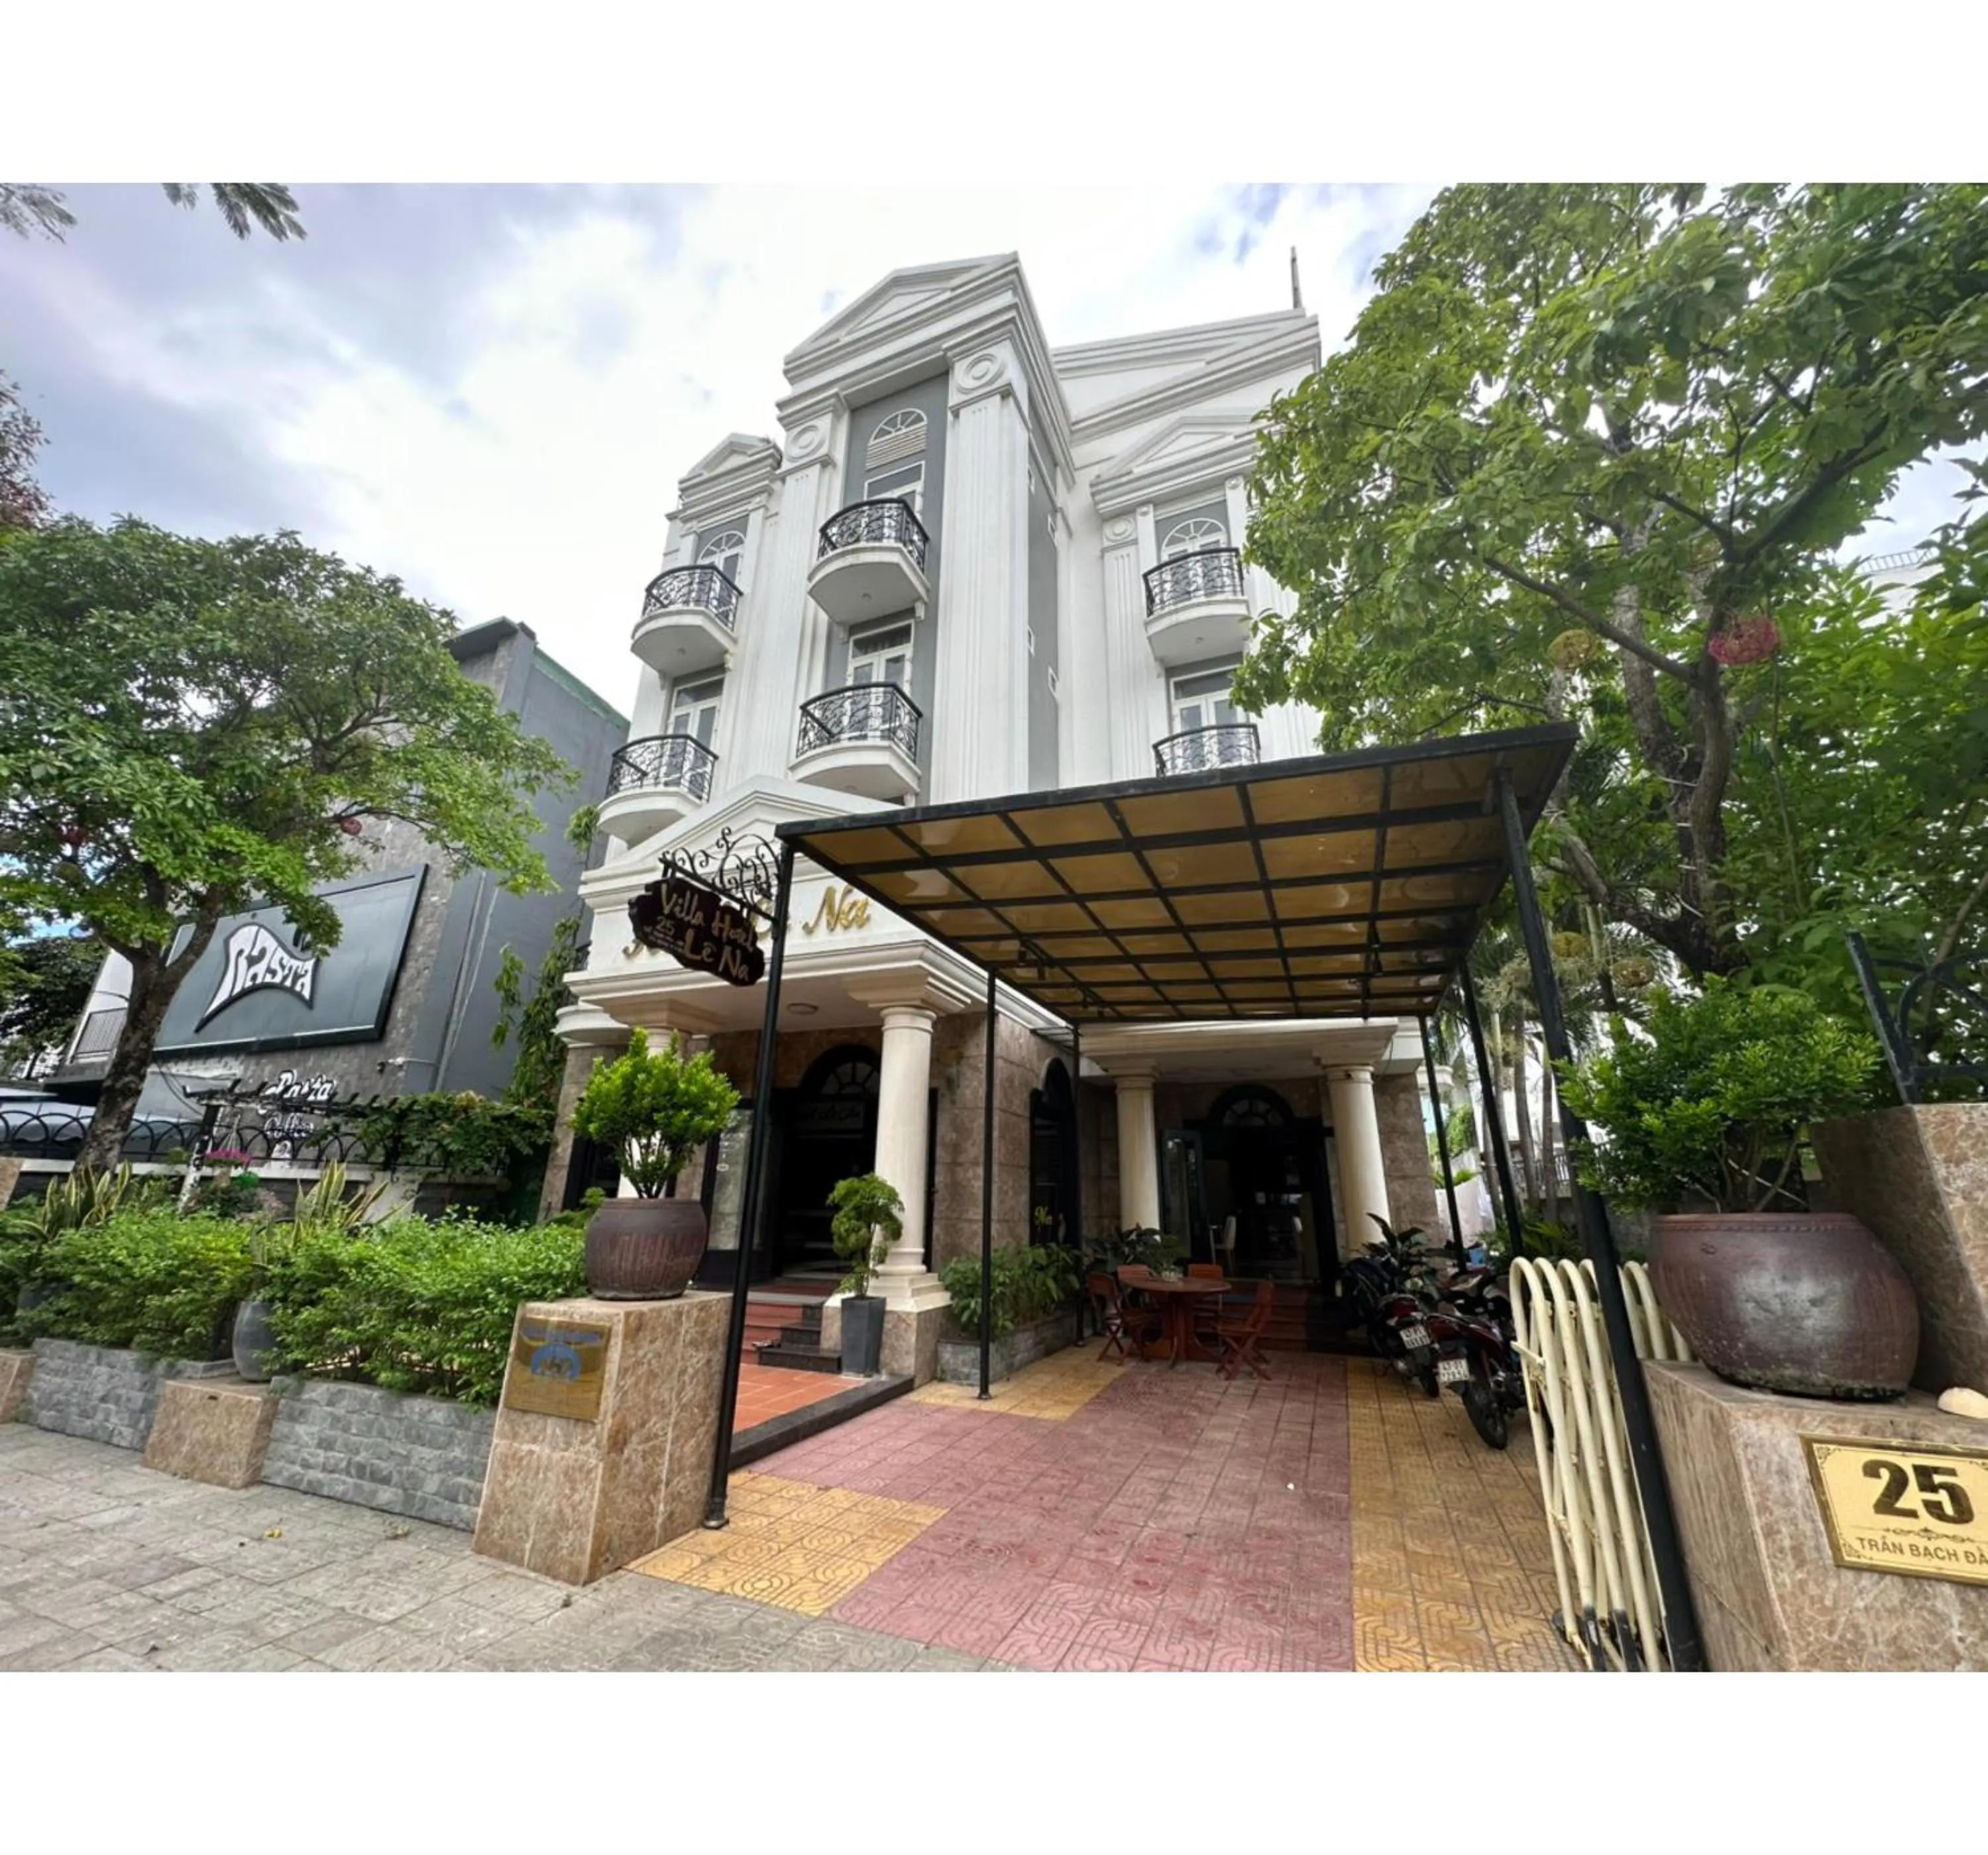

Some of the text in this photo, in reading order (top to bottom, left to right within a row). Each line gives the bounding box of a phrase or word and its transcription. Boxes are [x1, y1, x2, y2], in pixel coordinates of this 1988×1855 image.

[661, 883, 705, 926] Villa
[802, 885, 871, 935] Na
[718, 945, 749, 981] Na
[1861, 1459, 1974, 1524] 25
